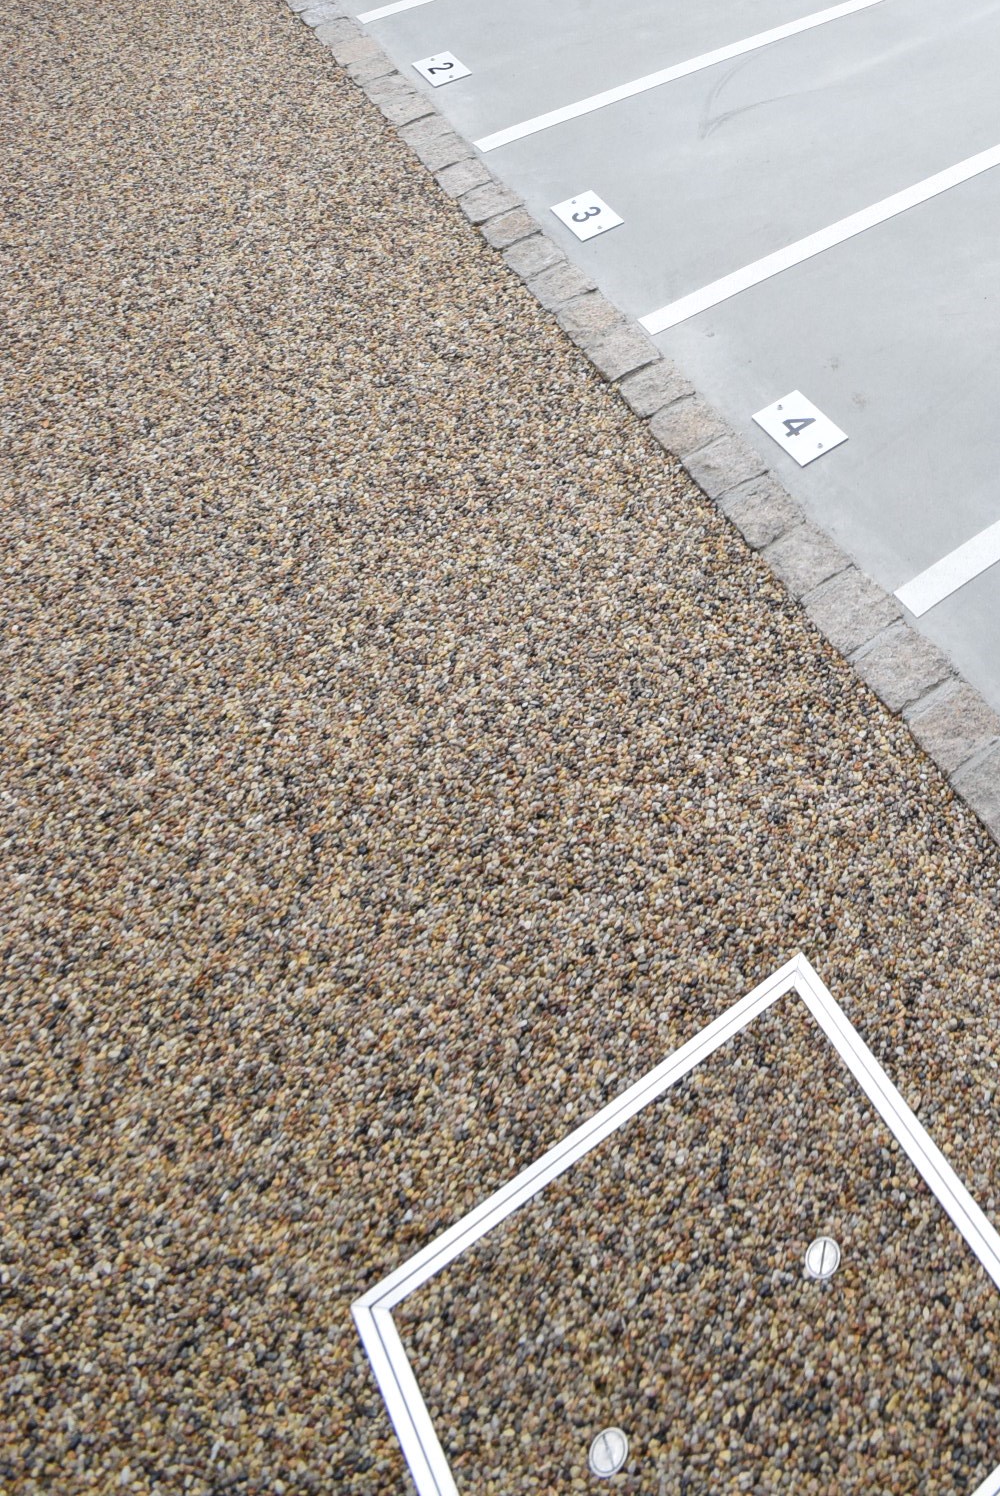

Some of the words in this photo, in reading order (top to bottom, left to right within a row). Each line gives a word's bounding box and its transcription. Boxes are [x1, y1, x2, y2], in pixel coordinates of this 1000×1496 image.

[427, 62, 454, 75] 2
[571, 206, 601, 223] 3
[782, 417, 816, 438] 4
